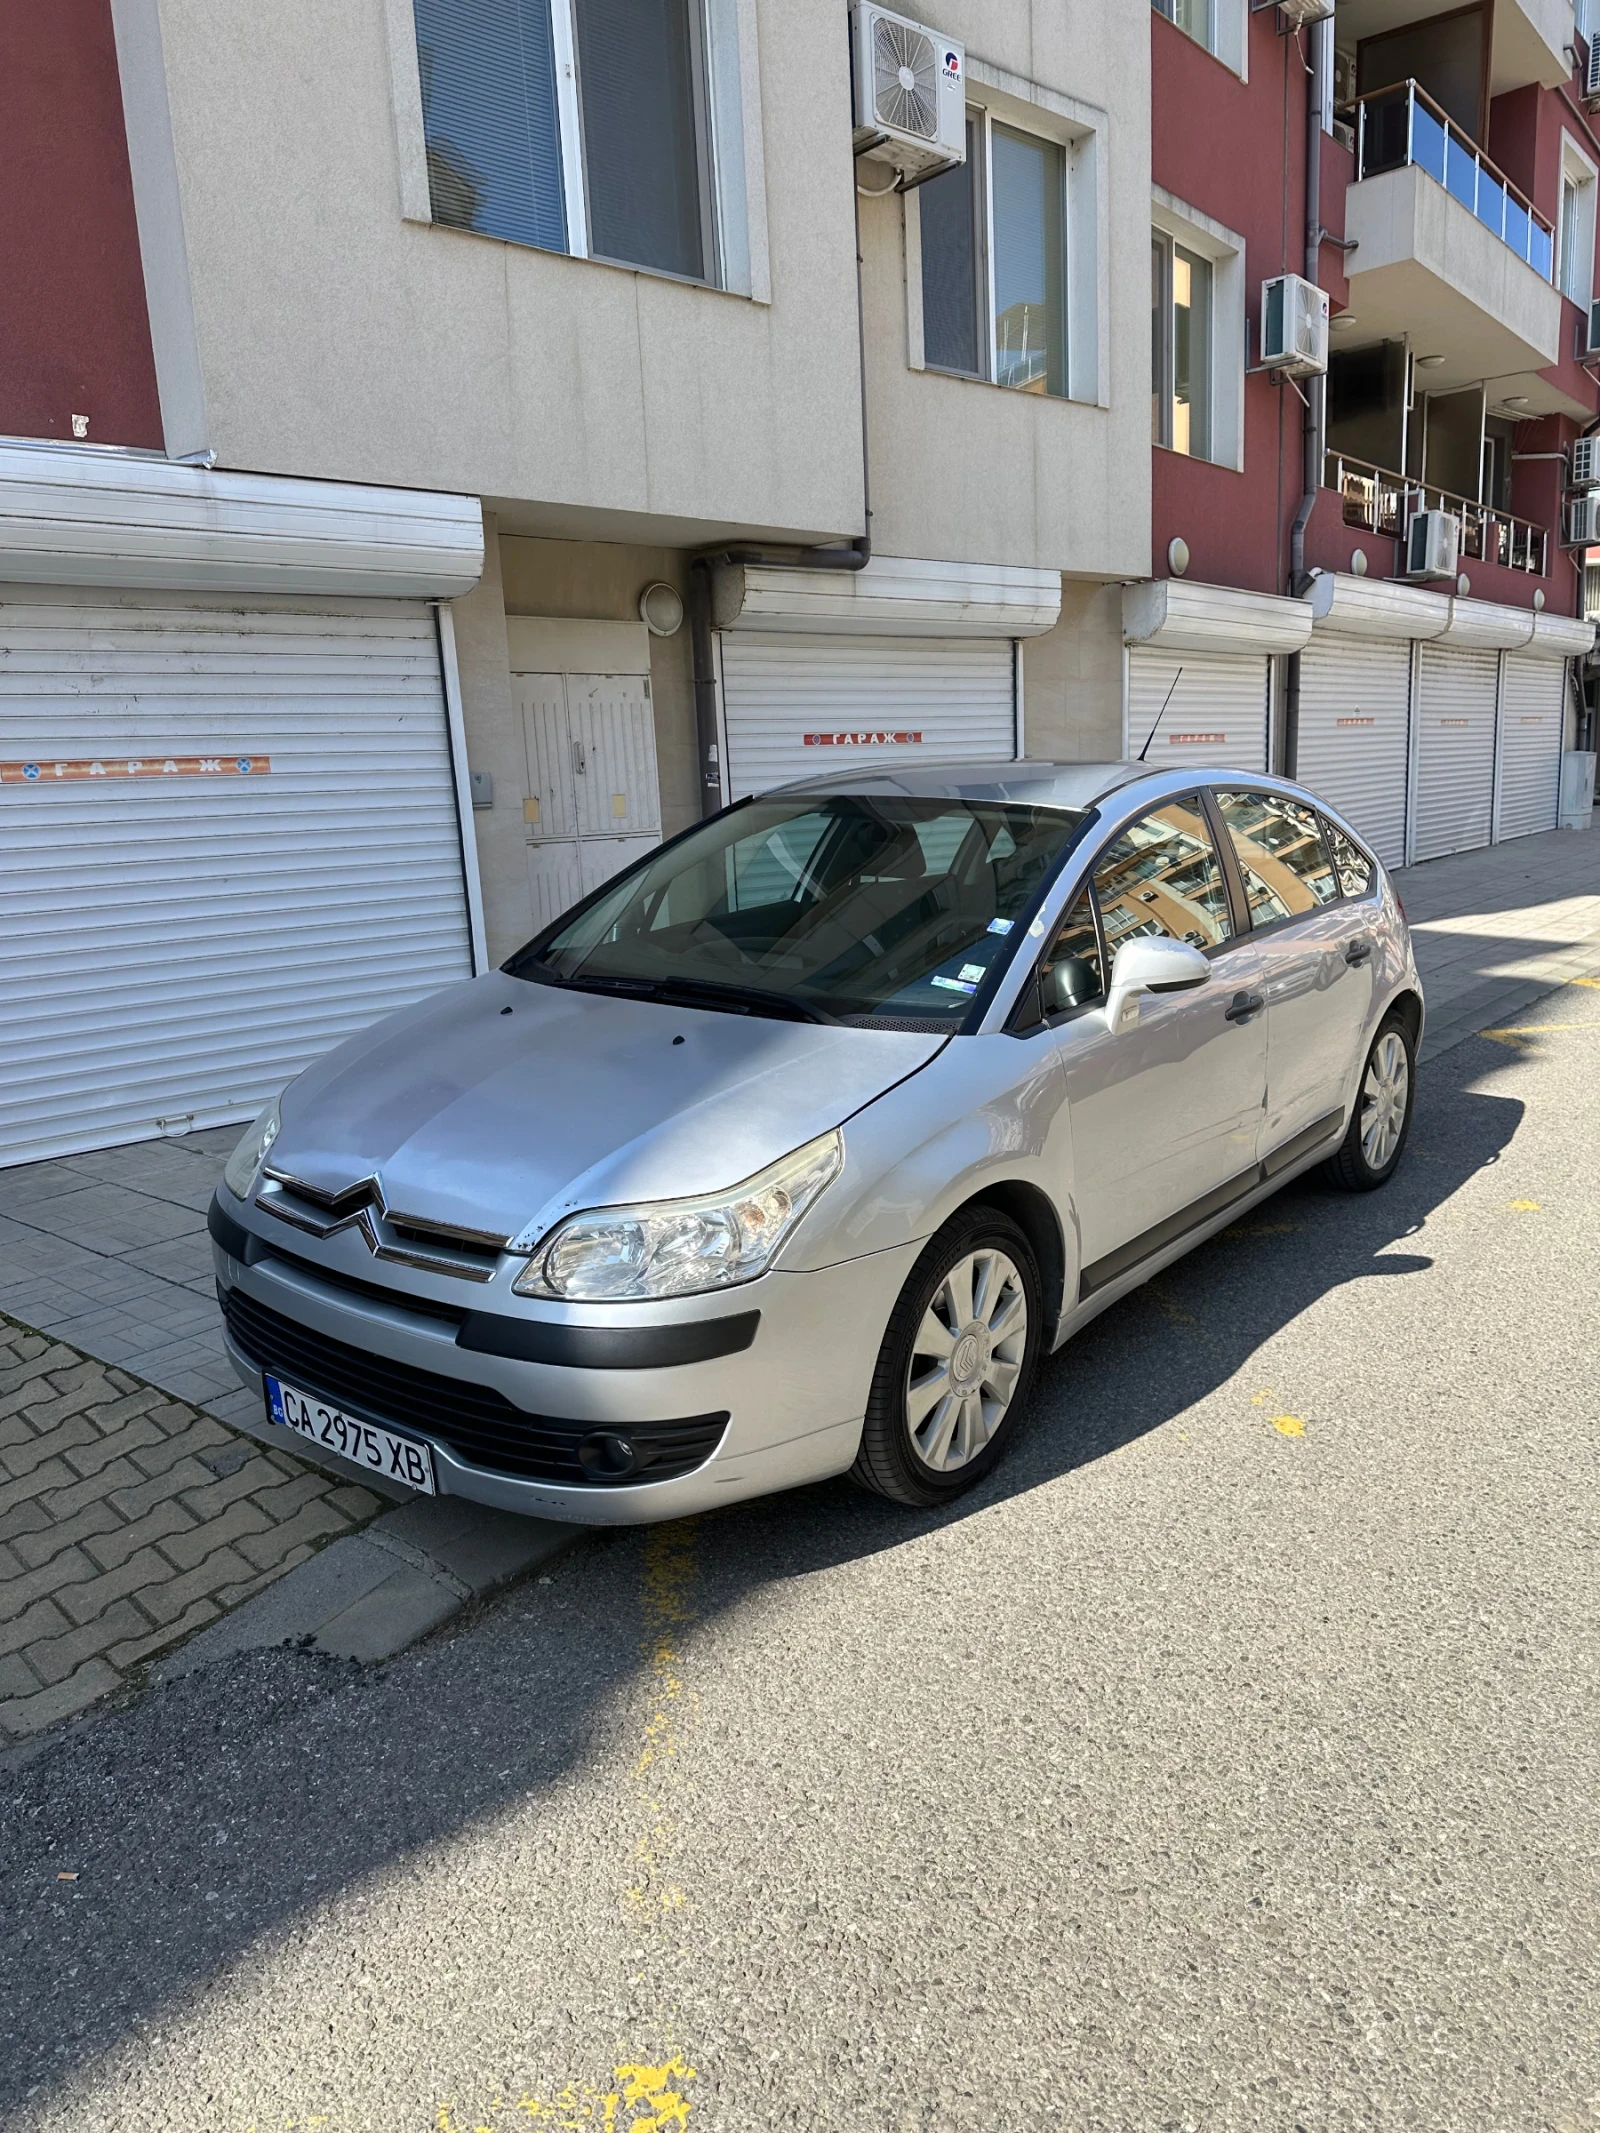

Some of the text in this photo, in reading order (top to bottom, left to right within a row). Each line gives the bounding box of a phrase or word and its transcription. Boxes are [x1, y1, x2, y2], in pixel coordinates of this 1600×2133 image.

[942, 68, 961, 83] GREE
[832, 732, 897, 745] ГАРАЖ
[54, 759, 222, 777] ГАРАЖ
[273, 1404, 284, 1418] BG
[317, 1408, 382, 1467] 2975
